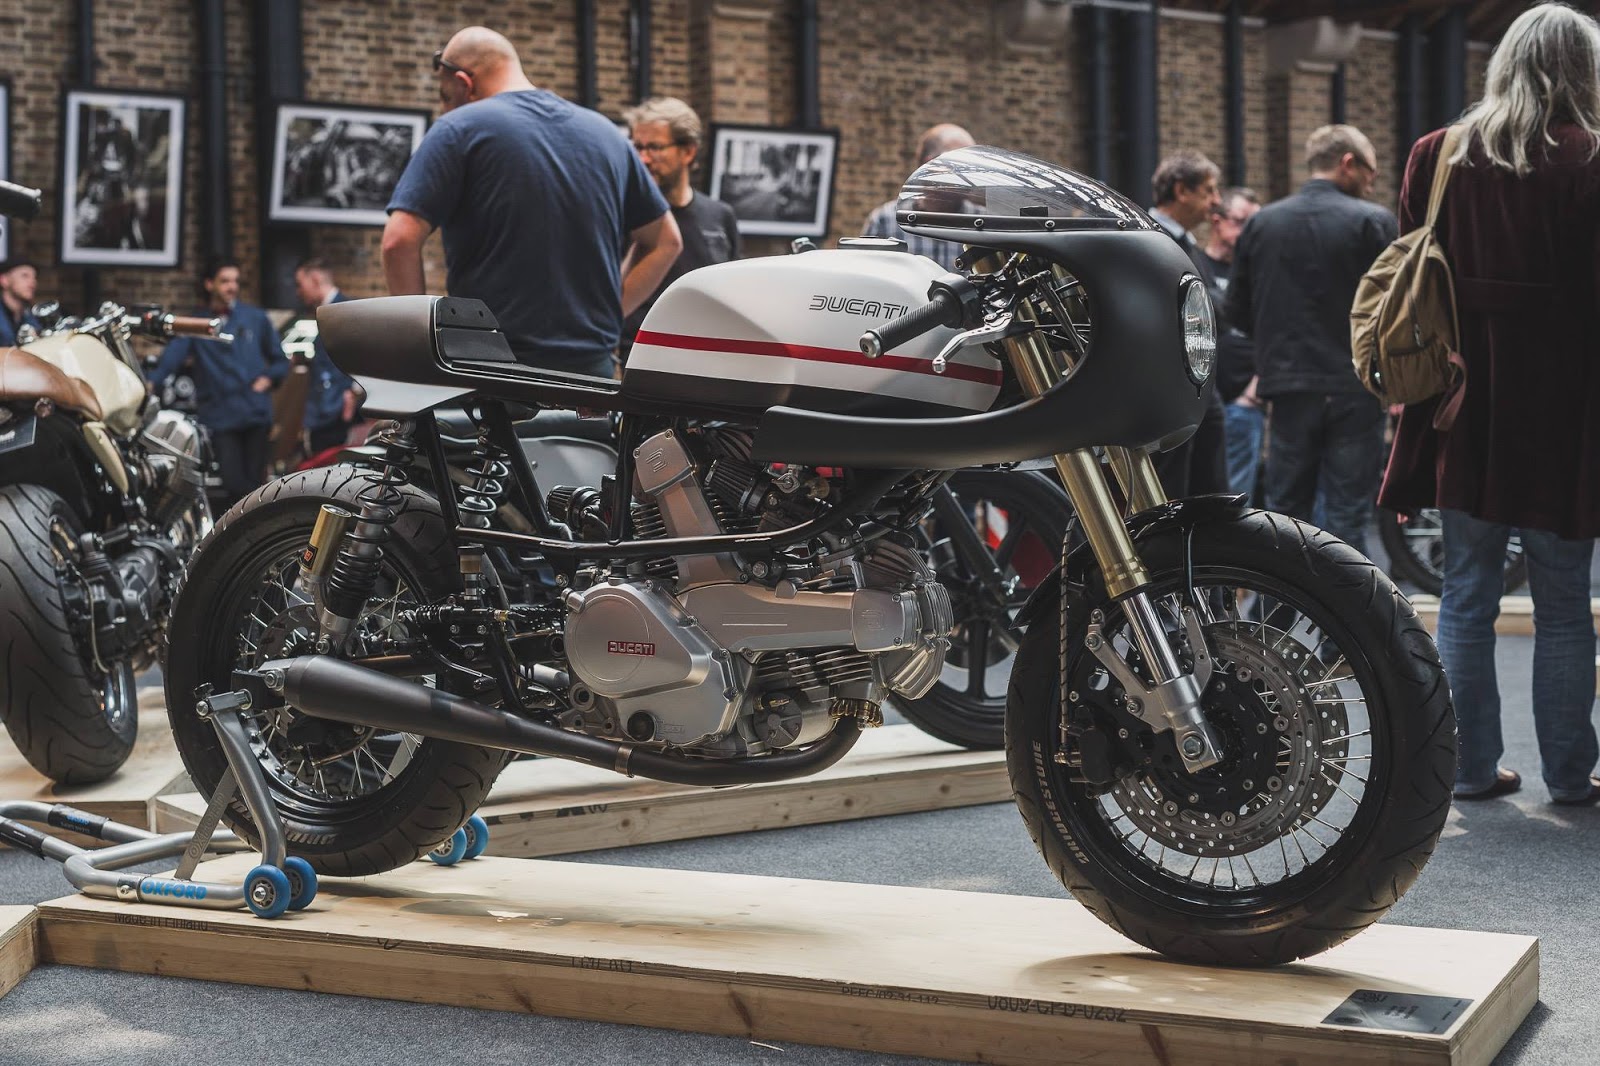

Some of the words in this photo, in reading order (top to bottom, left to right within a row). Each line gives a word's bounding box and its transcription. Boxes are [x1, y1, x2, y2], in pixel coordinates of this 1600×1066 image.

[809, 295, 908, 319] DUCATI
[609, 641, 654, 655] DUCATI
[1032, 740, 1090, 864] BRIDGESTONE
[141, 881, 207, 900] OXFORD
